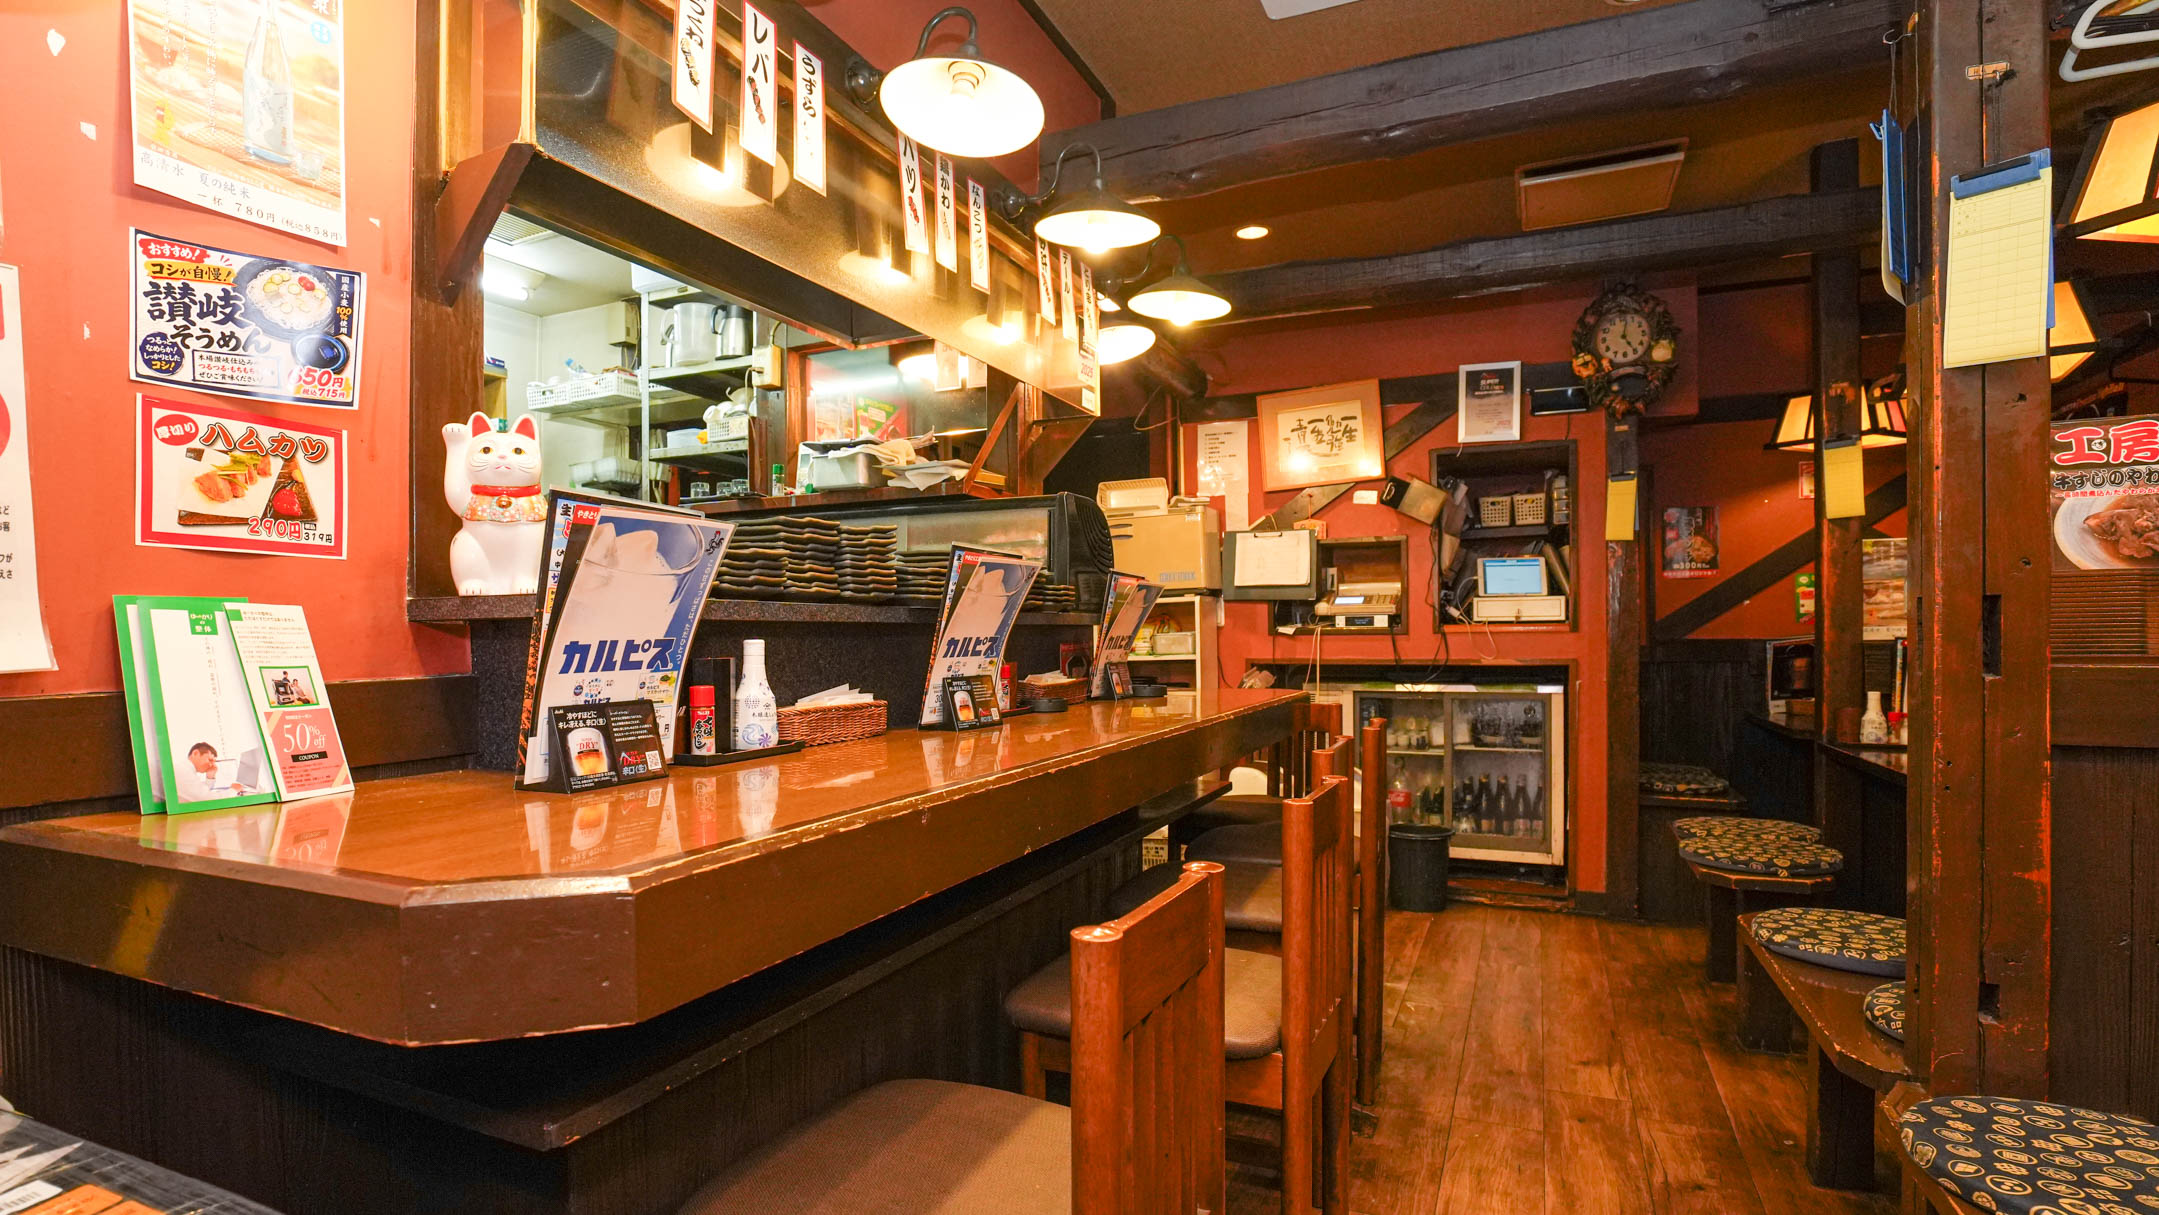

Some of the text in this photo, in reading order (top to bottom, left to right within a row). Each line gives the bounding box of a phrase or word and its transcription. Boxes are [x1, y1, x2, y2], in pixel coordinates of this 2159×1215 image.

[802, 54, 816, 118] うずら
[170, 324, 271, 353] そうめん
[198, 355, 260, 366] 本場讃岐仕込み
[199, 422, 328, 462] ハムカツ
[2054, 420, 2159, 465] 工房
[247, 516, 302, 541] 290円
[558, 638, 677, 675] カルピス
[942, 636, 1000, 659] カルピス
